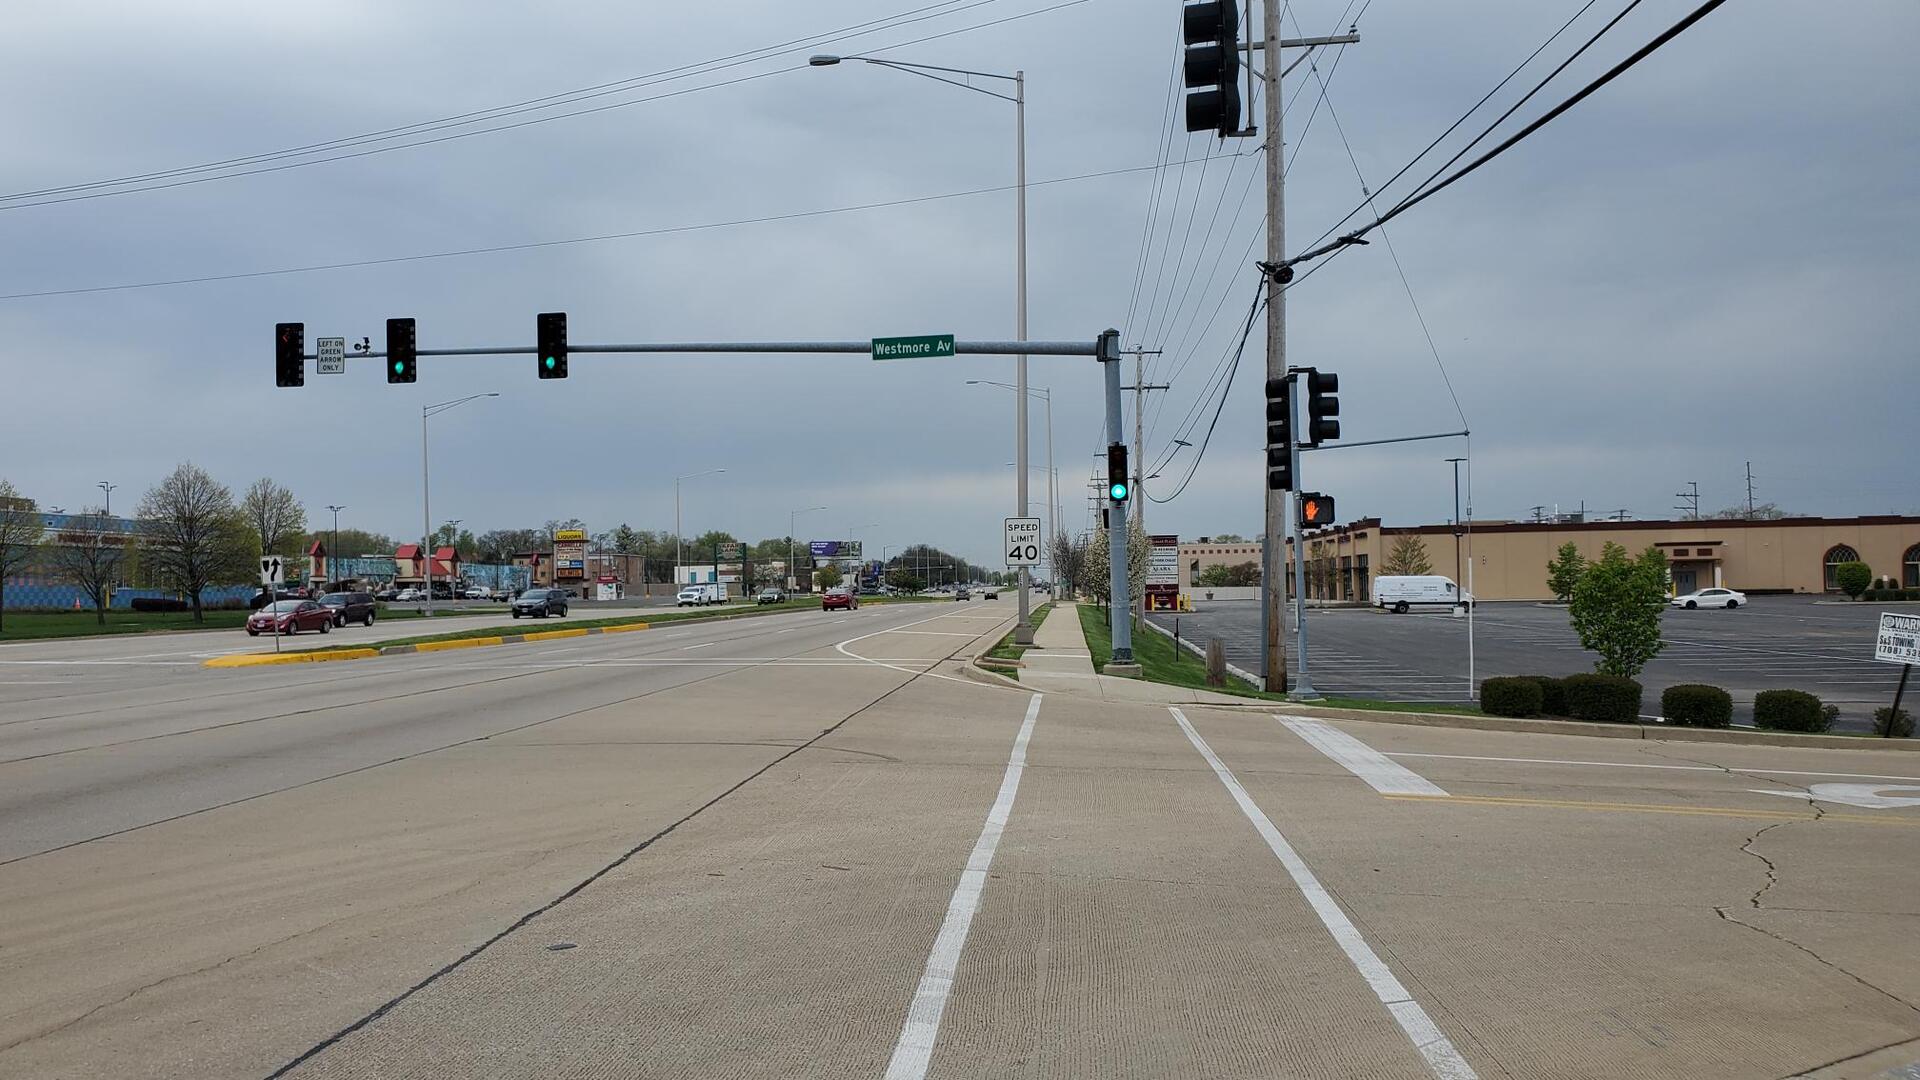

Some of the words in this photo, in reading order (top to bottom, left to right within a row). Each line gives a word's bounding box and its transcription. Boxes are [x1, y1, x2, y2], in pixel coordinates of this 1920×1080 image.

[318, 340, 333, 348] LEFT
[875, 342, 930, 355] Westmore
[936, 340, 951, 352] Av
[1008, 523, 1038, 532] SPEED
[1011, 535, 1035, 543] LIMIT
[1008, 545, 1038, 561] 40
[1892, 636, 1916, 648] TOWING
[1878, 645, 1902, 655] (708)
